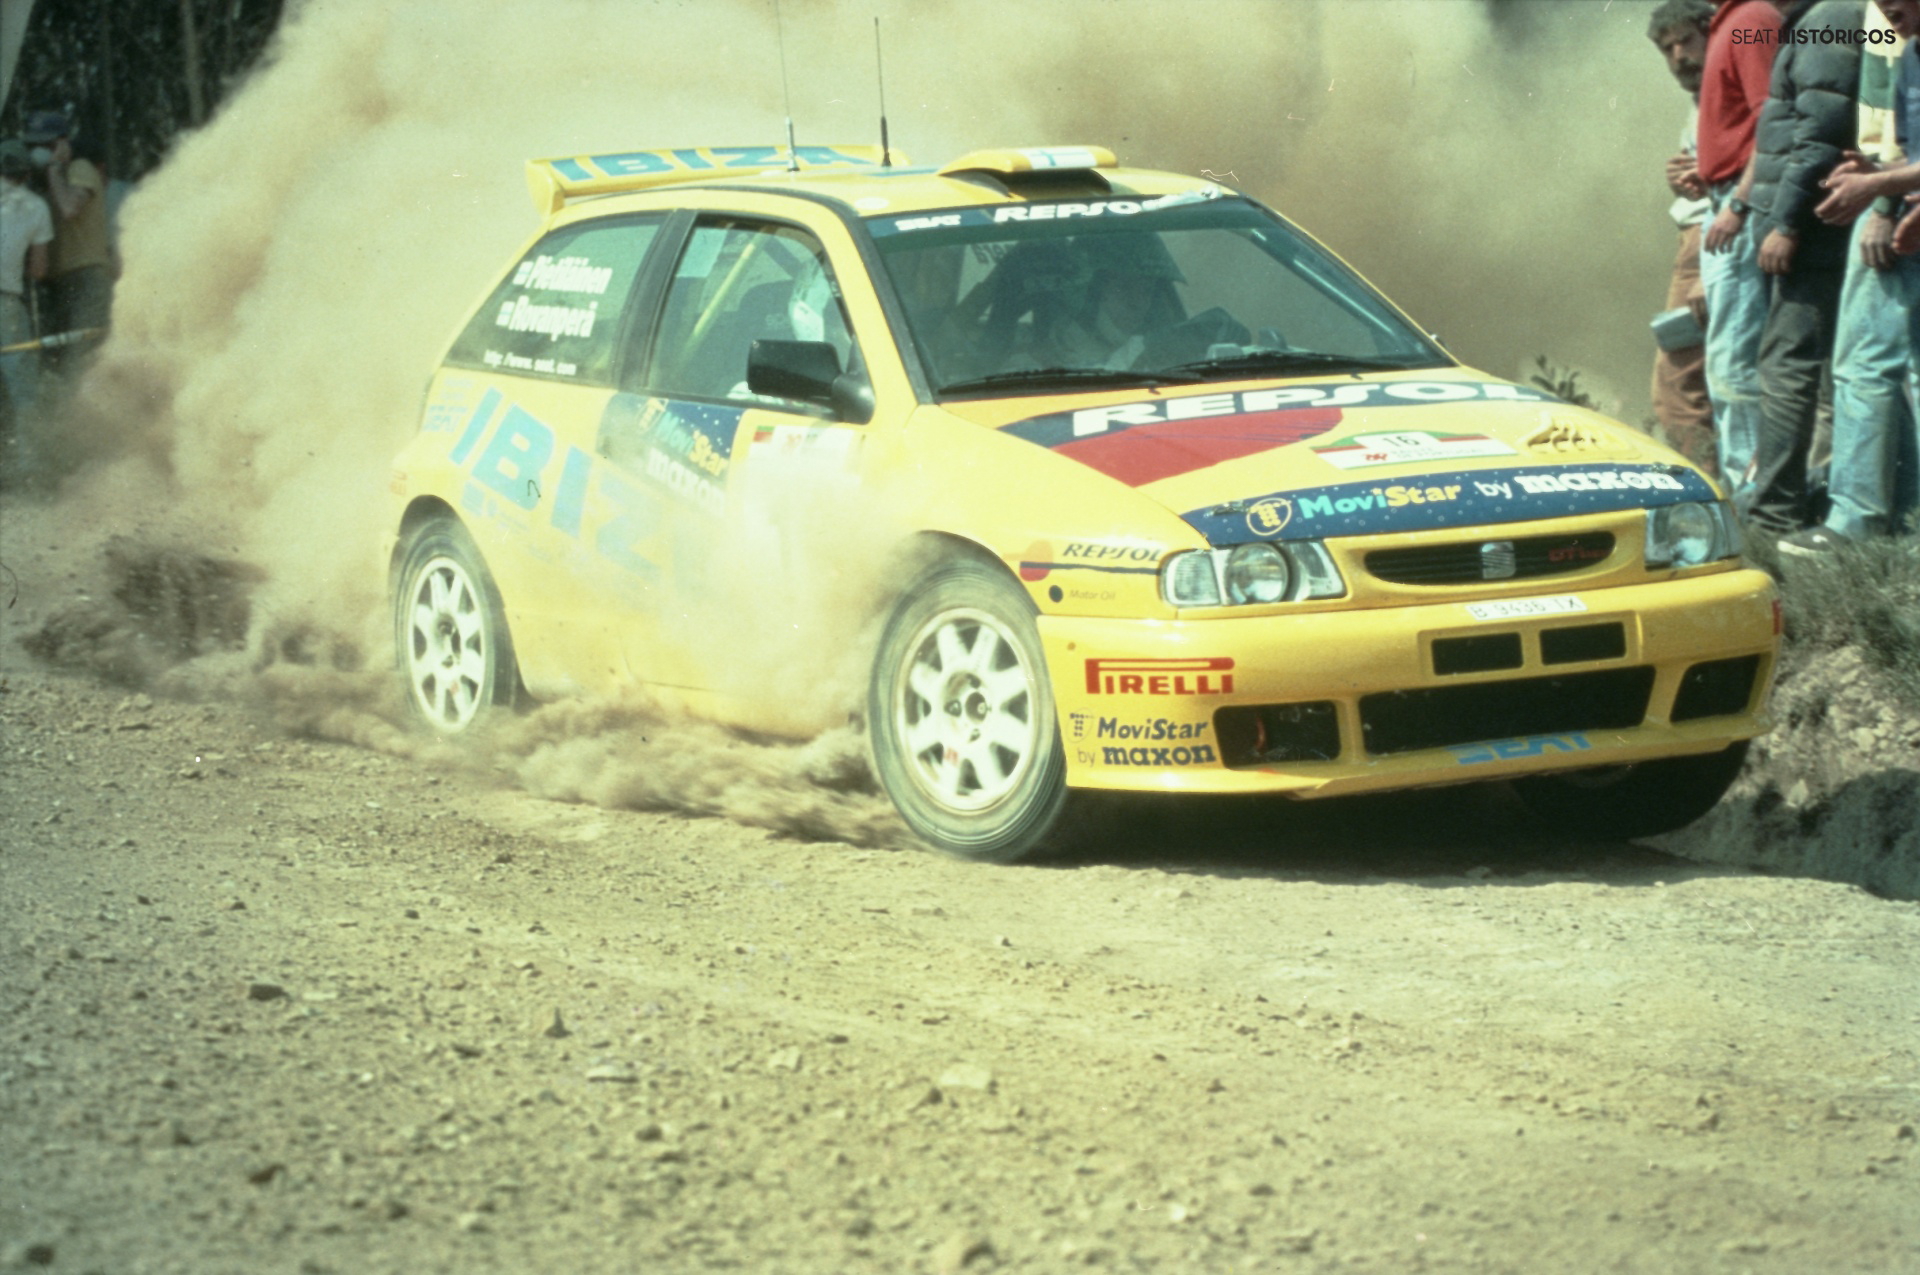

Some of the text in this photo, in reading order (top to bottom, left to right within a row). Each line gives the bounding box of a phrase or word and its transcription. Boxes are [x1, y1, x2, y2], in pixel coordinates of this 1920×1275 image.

[550, 146, 876, 182] IBIZA
[993, 200, 1160, 223] REPSO
[1073, 382, 1541, 437] REPSOL
[1299, 472, 1684, 520] MoviStar by maxon
[1063, 543, 1163, 562] REPSOL
[1085, 657, 1235, 695] PIRELLI
[1097, 716, 1208, 740] MoviStar
[1078, 744, 1217, 766] by maxon
